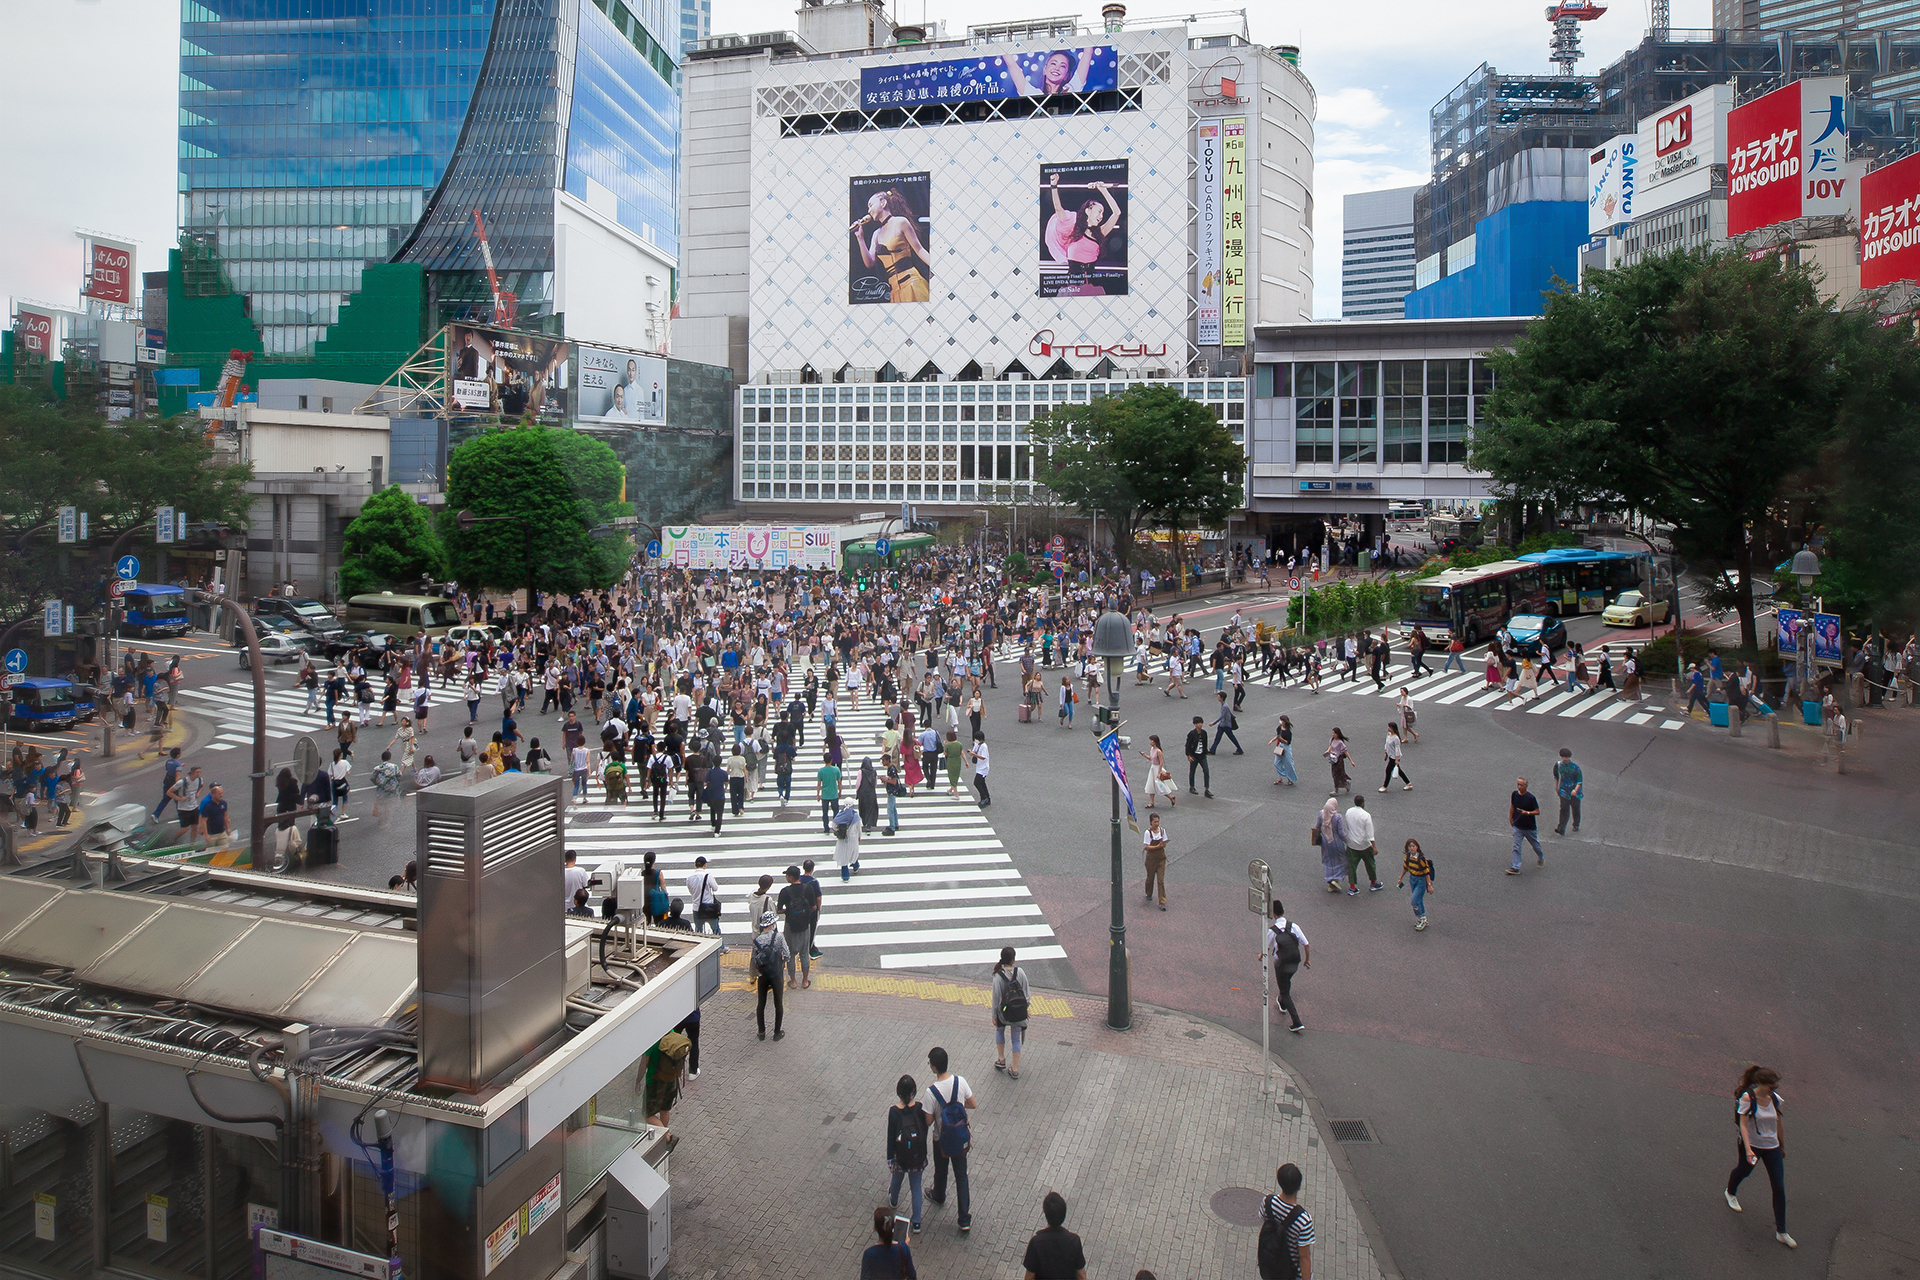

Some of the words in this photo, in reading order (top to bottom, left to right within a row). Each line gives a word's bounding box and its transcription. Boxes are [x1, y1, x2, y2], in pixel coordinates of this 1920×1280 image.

[866, 82, 1006, 104] 安室奈美恵、最後の作品。
[1193, 97, 1250, 107] TOKYU
[1658, 111, 1687, 151] DC
[1204, 139, 1214, 183] TOKYU
[1667, 151, 1683, 165] VISA
[1730, 128, 1798, 176] カラオケ
[1622, 142, 1638, 214] SANKYO
[1661, 155, 1698, 178] MasterCard
[1730, 156, 1799, 196] JOYSOUND
[1806, 179, 1846, 199] JOY
[1204, 185, 1214, 221] CARD
[1224, 156, 1243, 314] 九州浪漫紀行
[1052, 343, 1166, 357] TOKYU
[583, 355, 618, 370] ミノキなら、
[583, 373, 606, 386] 生える。
